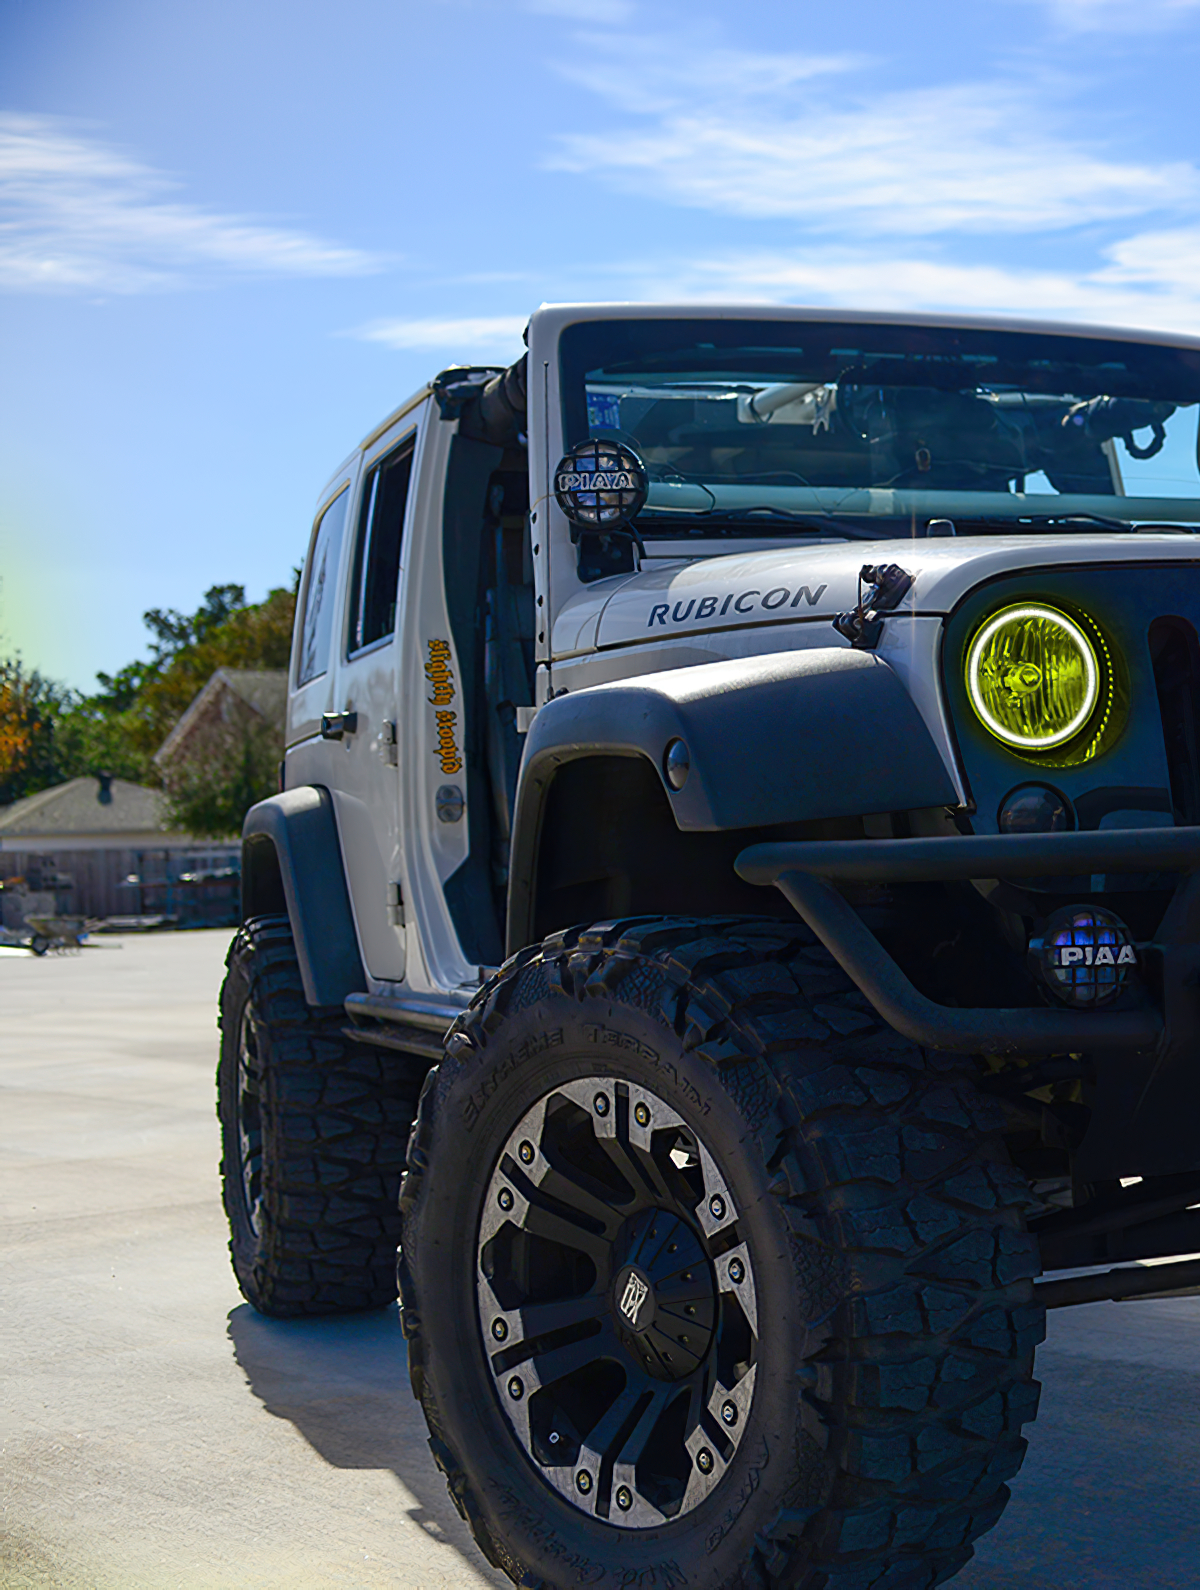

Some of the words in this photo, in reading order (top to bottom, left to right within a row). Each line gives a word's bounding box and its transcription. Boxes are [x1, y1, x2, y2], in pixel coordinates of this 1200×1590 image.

[558, 471, 635, 492] PIAA
[647, 584, 828, 628] RUBICON
[1061, 945, 1137, 966] PIAA
